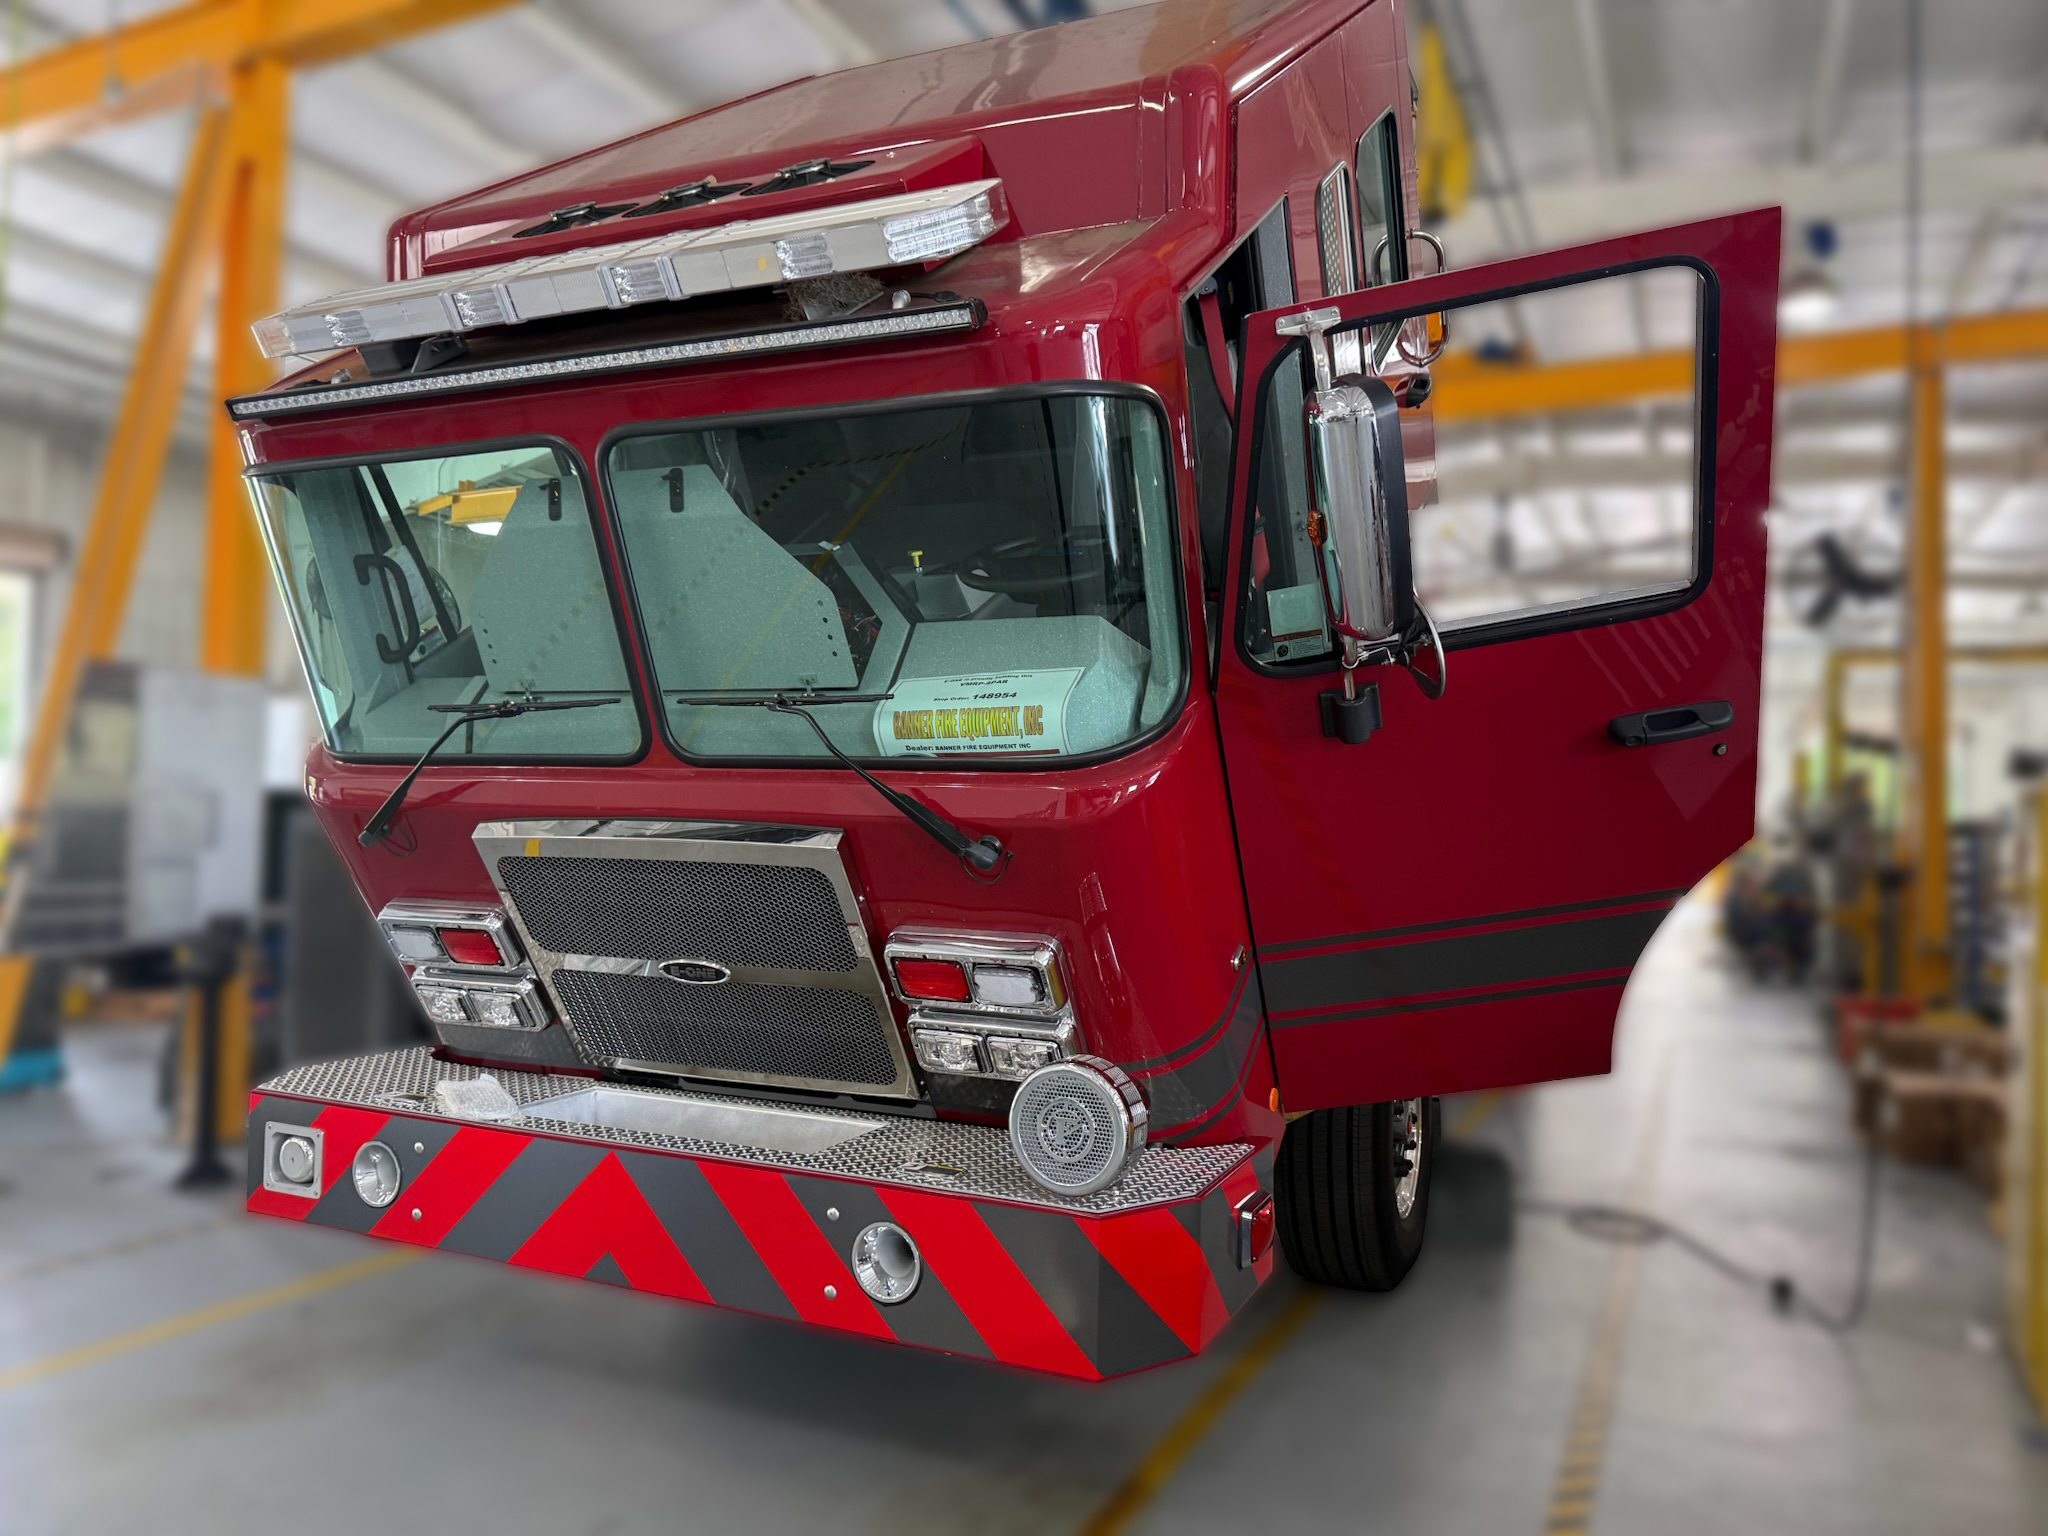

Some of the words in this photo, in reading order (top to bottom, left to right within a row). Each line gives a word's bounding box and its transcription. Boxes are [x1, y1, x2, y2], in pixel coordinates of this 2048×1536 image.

[972, 692, 1018, 700] 148954
[892, 709, 936, 740] BANNER
[935, 709, 959, 738] FIRE
[959, 706, 1023, 741] EQUIPMENT,
[1023, 704, 1044, 736] INC
[670, 965, 716, 978] E-ONE
